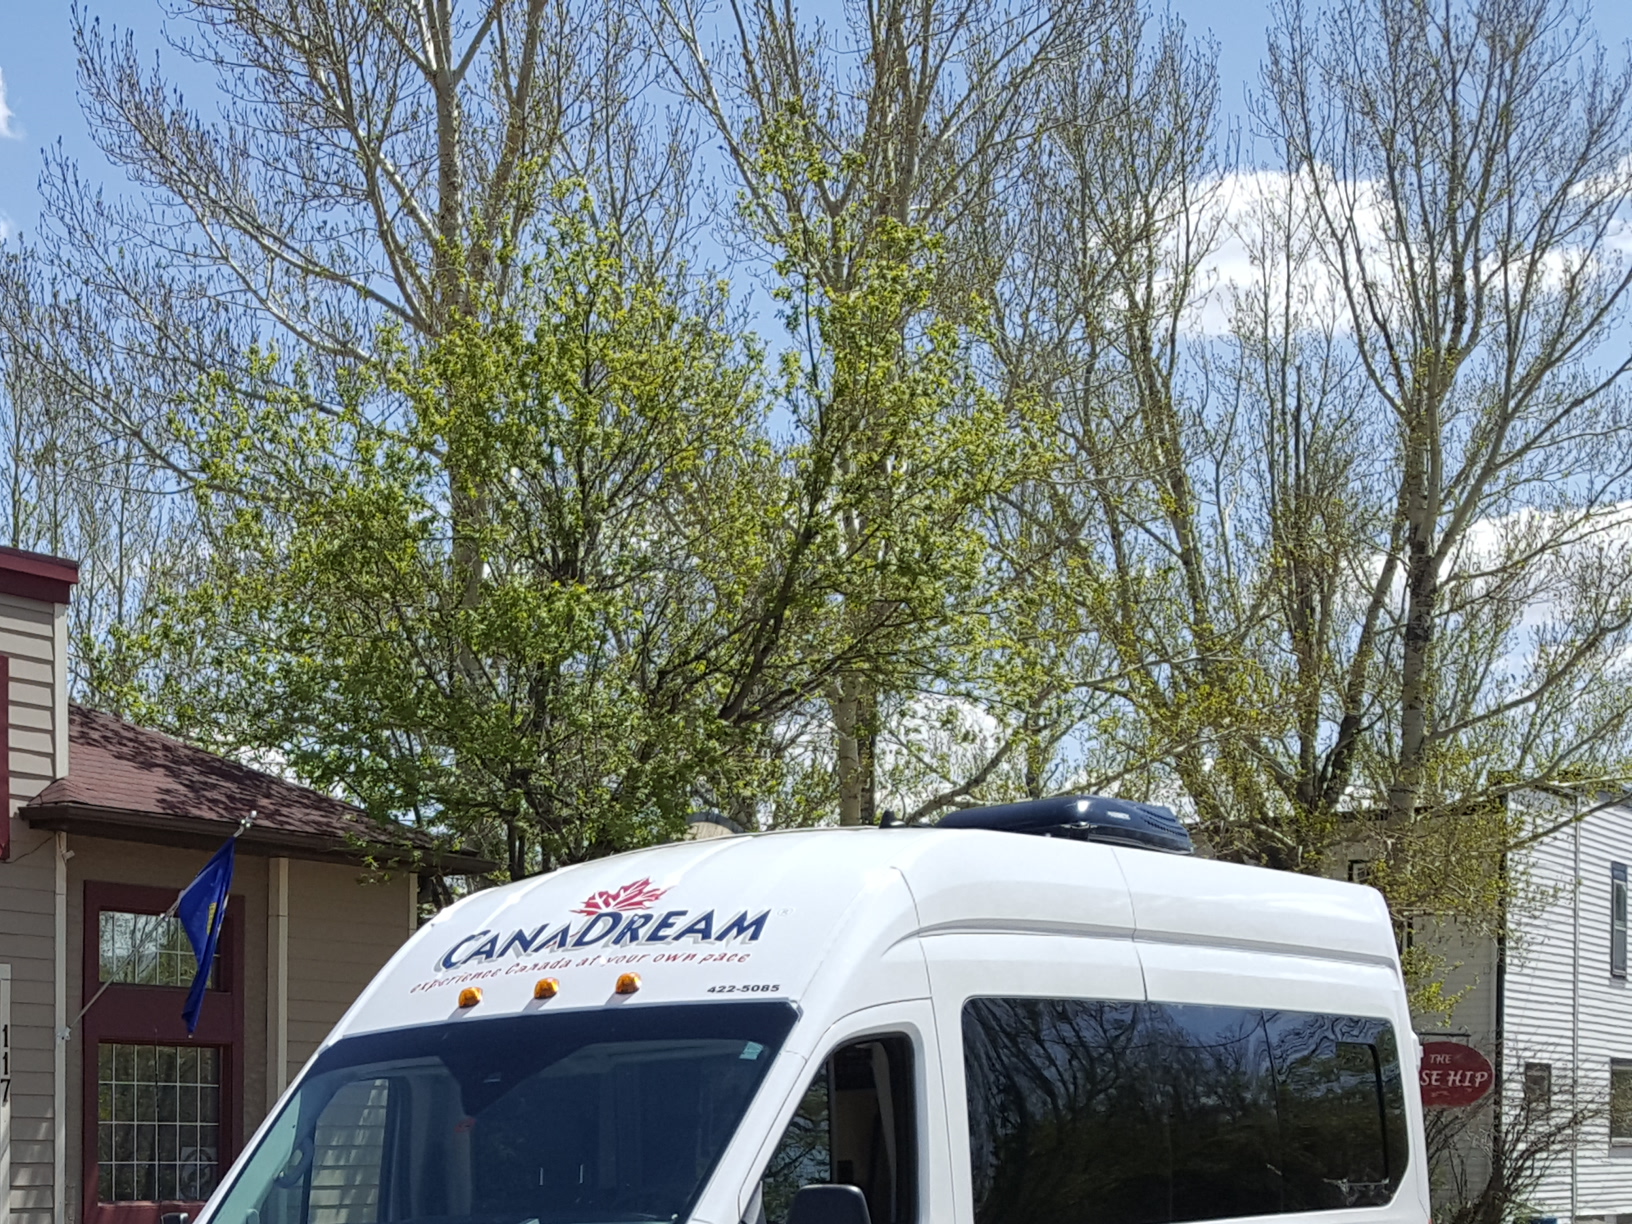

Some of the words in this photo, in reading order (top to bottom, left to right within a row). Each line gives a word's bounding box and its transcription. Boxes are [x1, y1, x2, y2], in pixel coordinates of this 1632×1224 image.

[410, 968, 502, 994] experience
[505, 956, 570, 975] Canada
[575, 954, 600, 967] at
[599, 953, 651, 968] your
[652, 952, 698, 963] own
[698, 952, 752, 965] pace
[707, 984, 781, 994] 422-5085
[0, 1024, 11, 1106] 117
[1429, 1053, 1453, 1065] THE
[1420, 1069, 1443, 1086] SE
[1446, 1069, 1489, 1088] HIP
